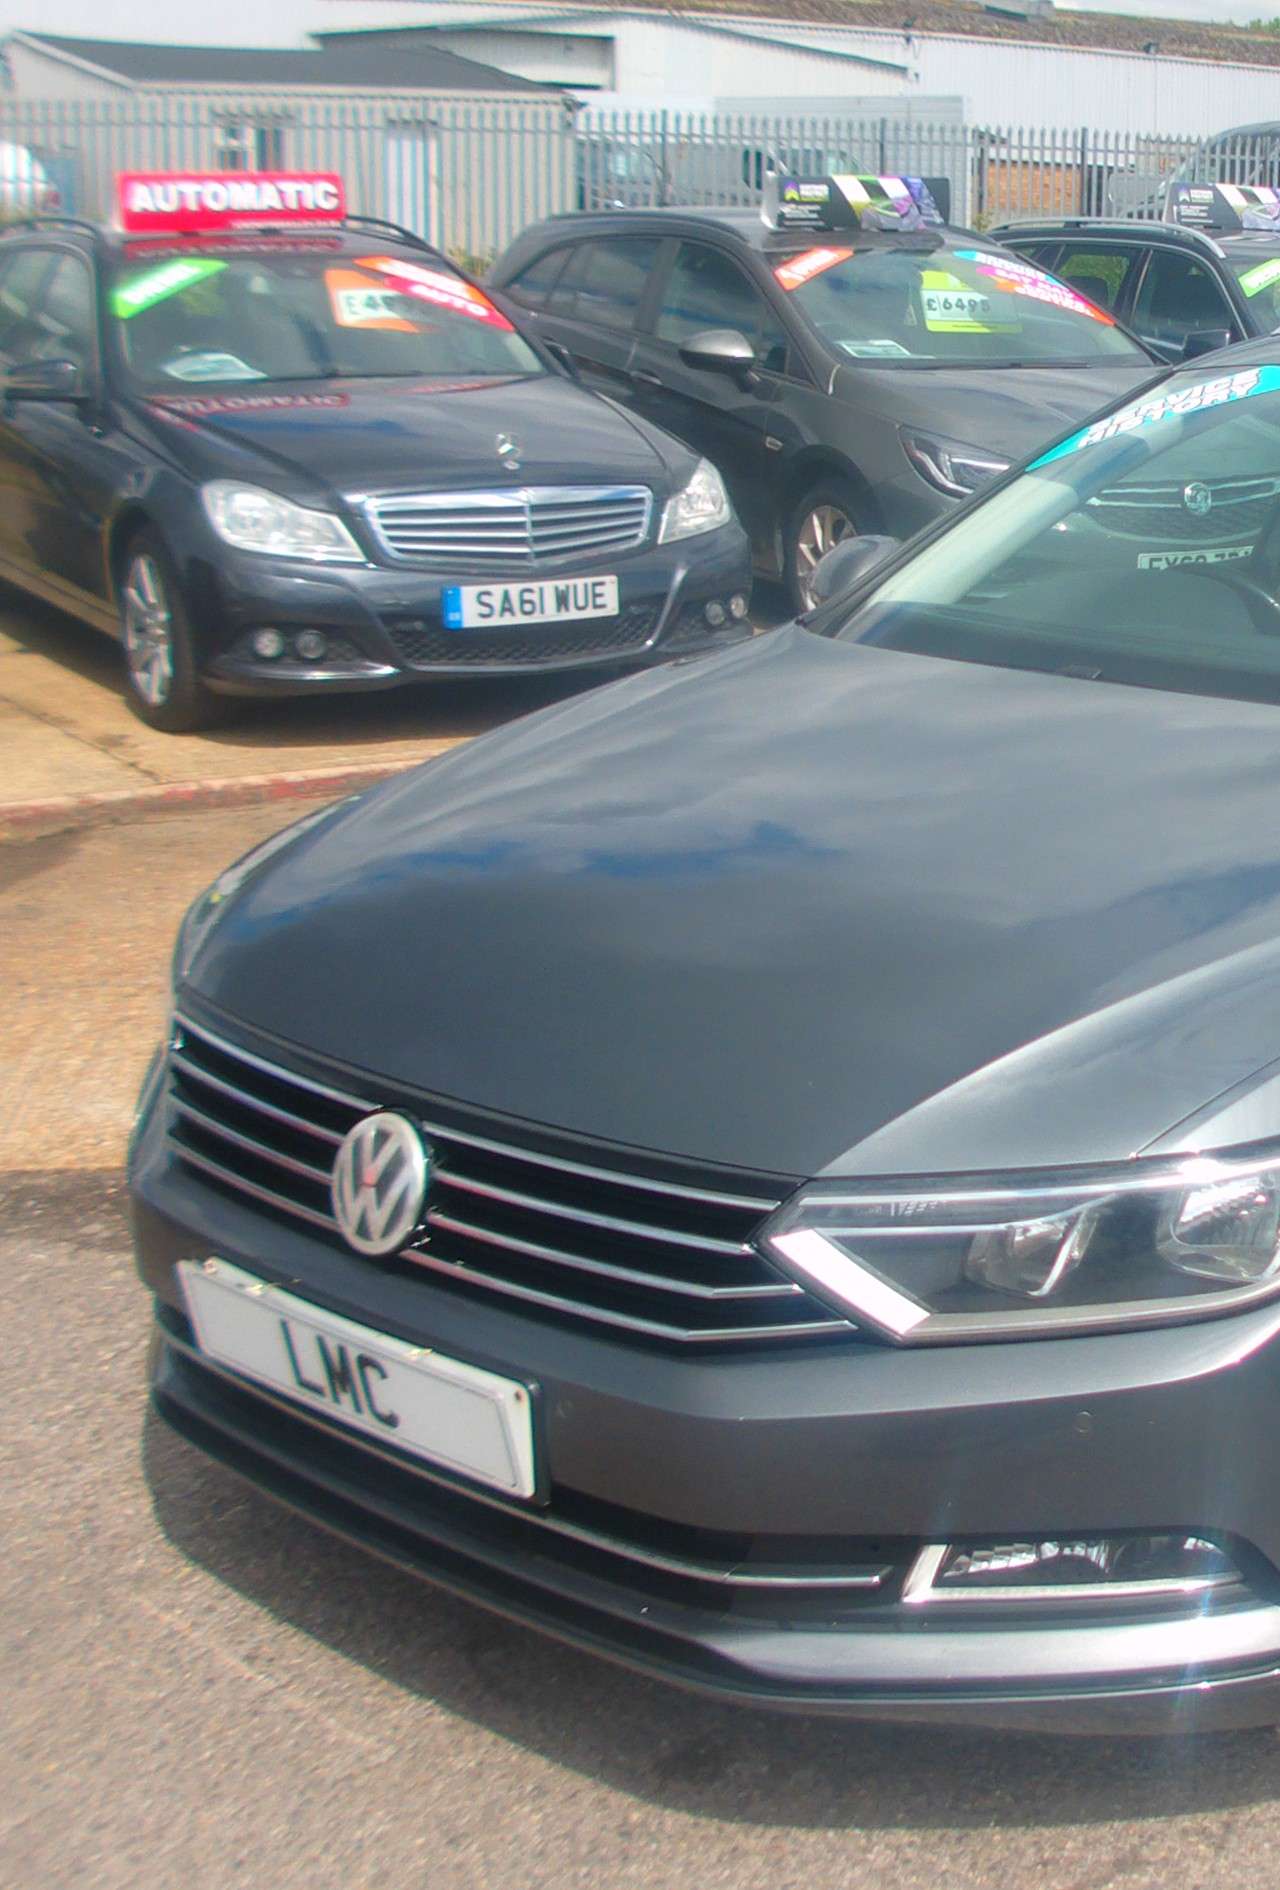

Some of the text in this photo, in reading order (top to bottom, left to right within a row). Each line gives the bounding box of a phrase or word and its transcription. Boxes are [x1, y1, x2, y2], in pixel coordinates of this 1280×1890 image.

[127, 180, 341, 212] AUTOMATIC
[926, 297, 992, 312] £6495
[475, 581, 607, 619] SA61 WUE
[281, 1319, 399, 1429] LMC
